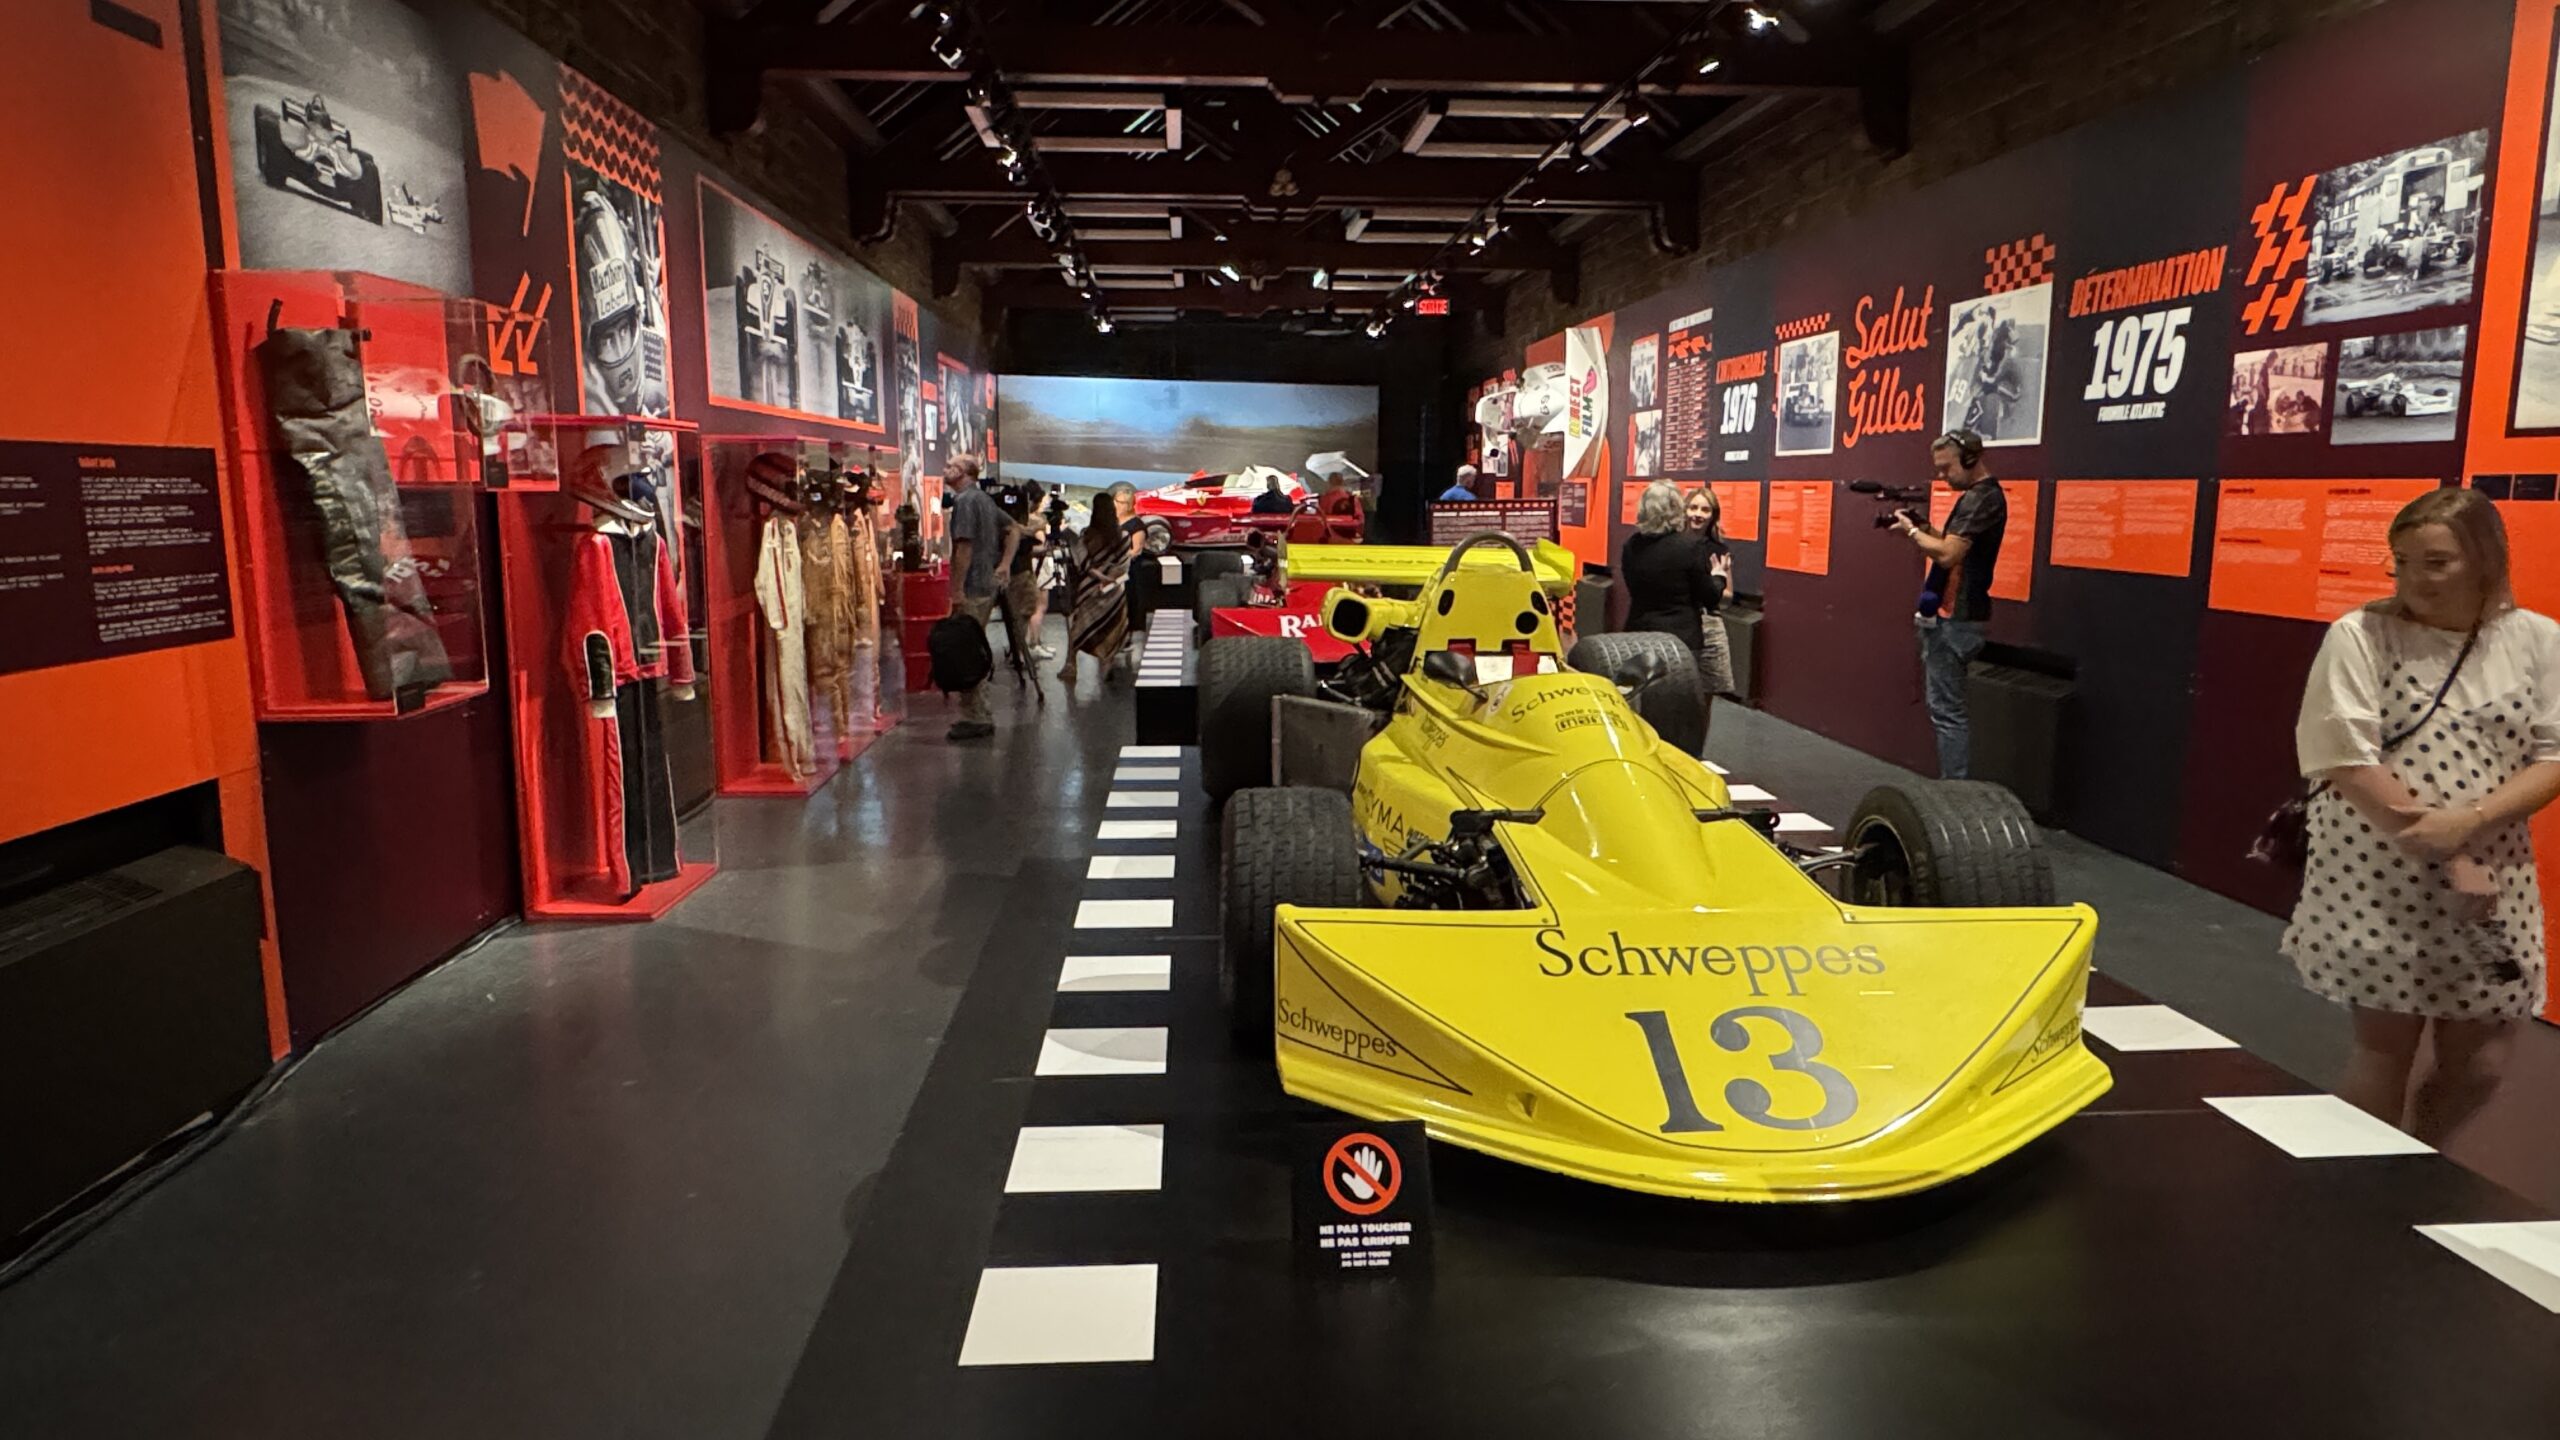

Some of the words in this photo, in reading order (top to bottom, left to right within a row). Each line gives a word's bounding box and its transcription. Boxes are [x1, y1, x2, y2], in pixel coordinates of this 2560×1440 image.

[2068, 245, 2228, 318] DÉTERMINATION
[1846, 284, 1934, 369] Salut
[2083, 306, 2192, 400] 1975
[1582, 395, 1594, 437] FILM
[1720, 382, 1758, 434] 1976
[1843, 366, 1924, 449] Gilles
[1535, 928, 1887, 996] Schweppes
[1278, 998, 1399, 1060] Schweppes
[1624, 1006, 1860, 1133] 13
[1337, 1224, 1359, 1234] PAS
[1361, 1222, 1412, 1233] TOUCHER
[1338, 1237, 1360, 1247] PAS
[1362, 1235, 1410, 1246] GRIMPER
